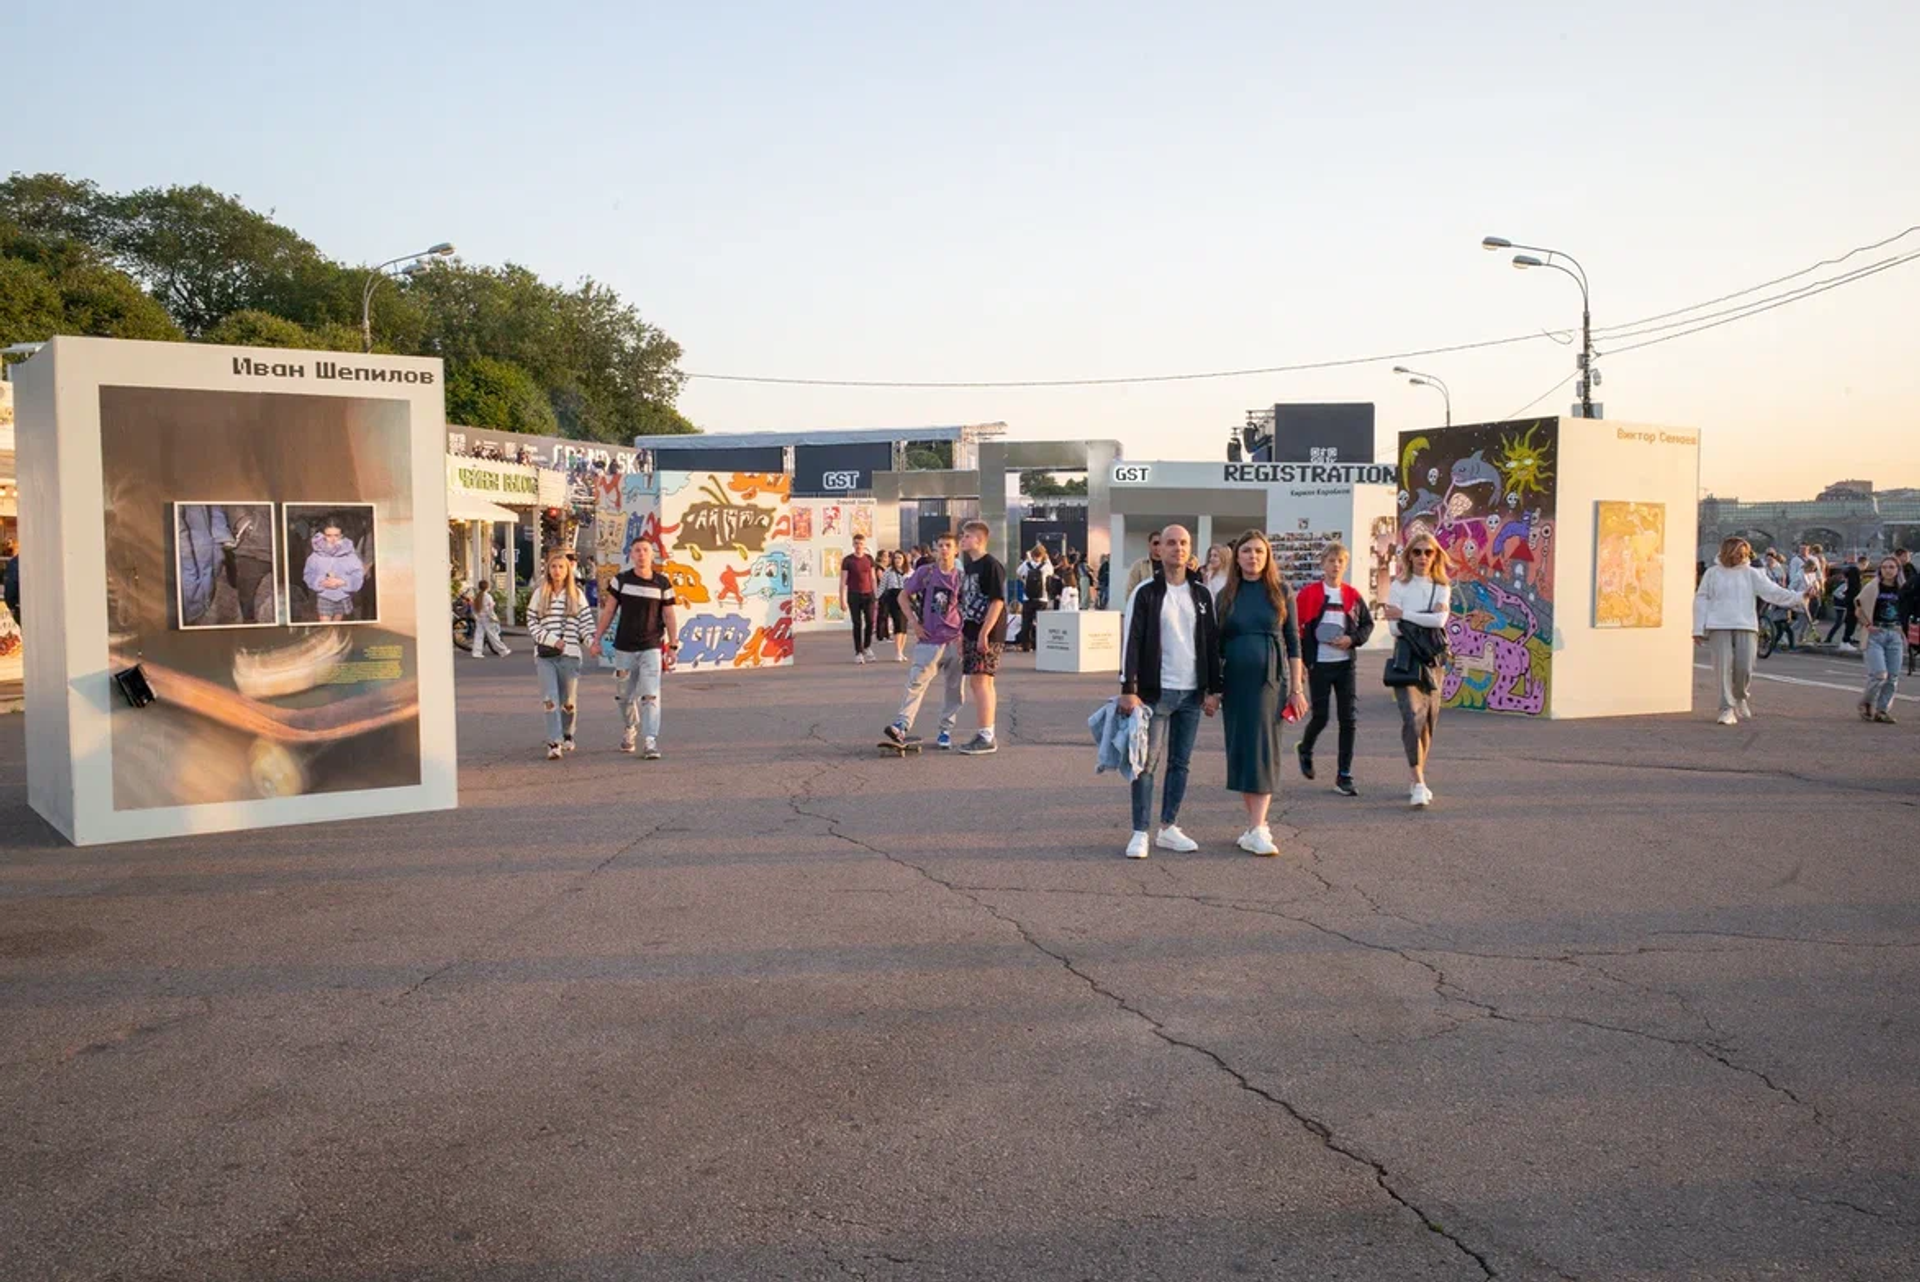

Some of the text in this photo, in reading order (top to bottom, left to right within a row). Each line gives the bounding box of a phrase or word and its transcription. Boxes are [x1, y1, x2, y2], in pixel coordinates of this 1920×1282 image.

[233, 357, 434, 385] Иван Шепилов
[1617, 427, 1656, 444] Виктор
[823, 471, 859, 489] GST
[1114, 466, 1150, 482] GST
[1224, 464, 1397, 483] REGISTRATION
